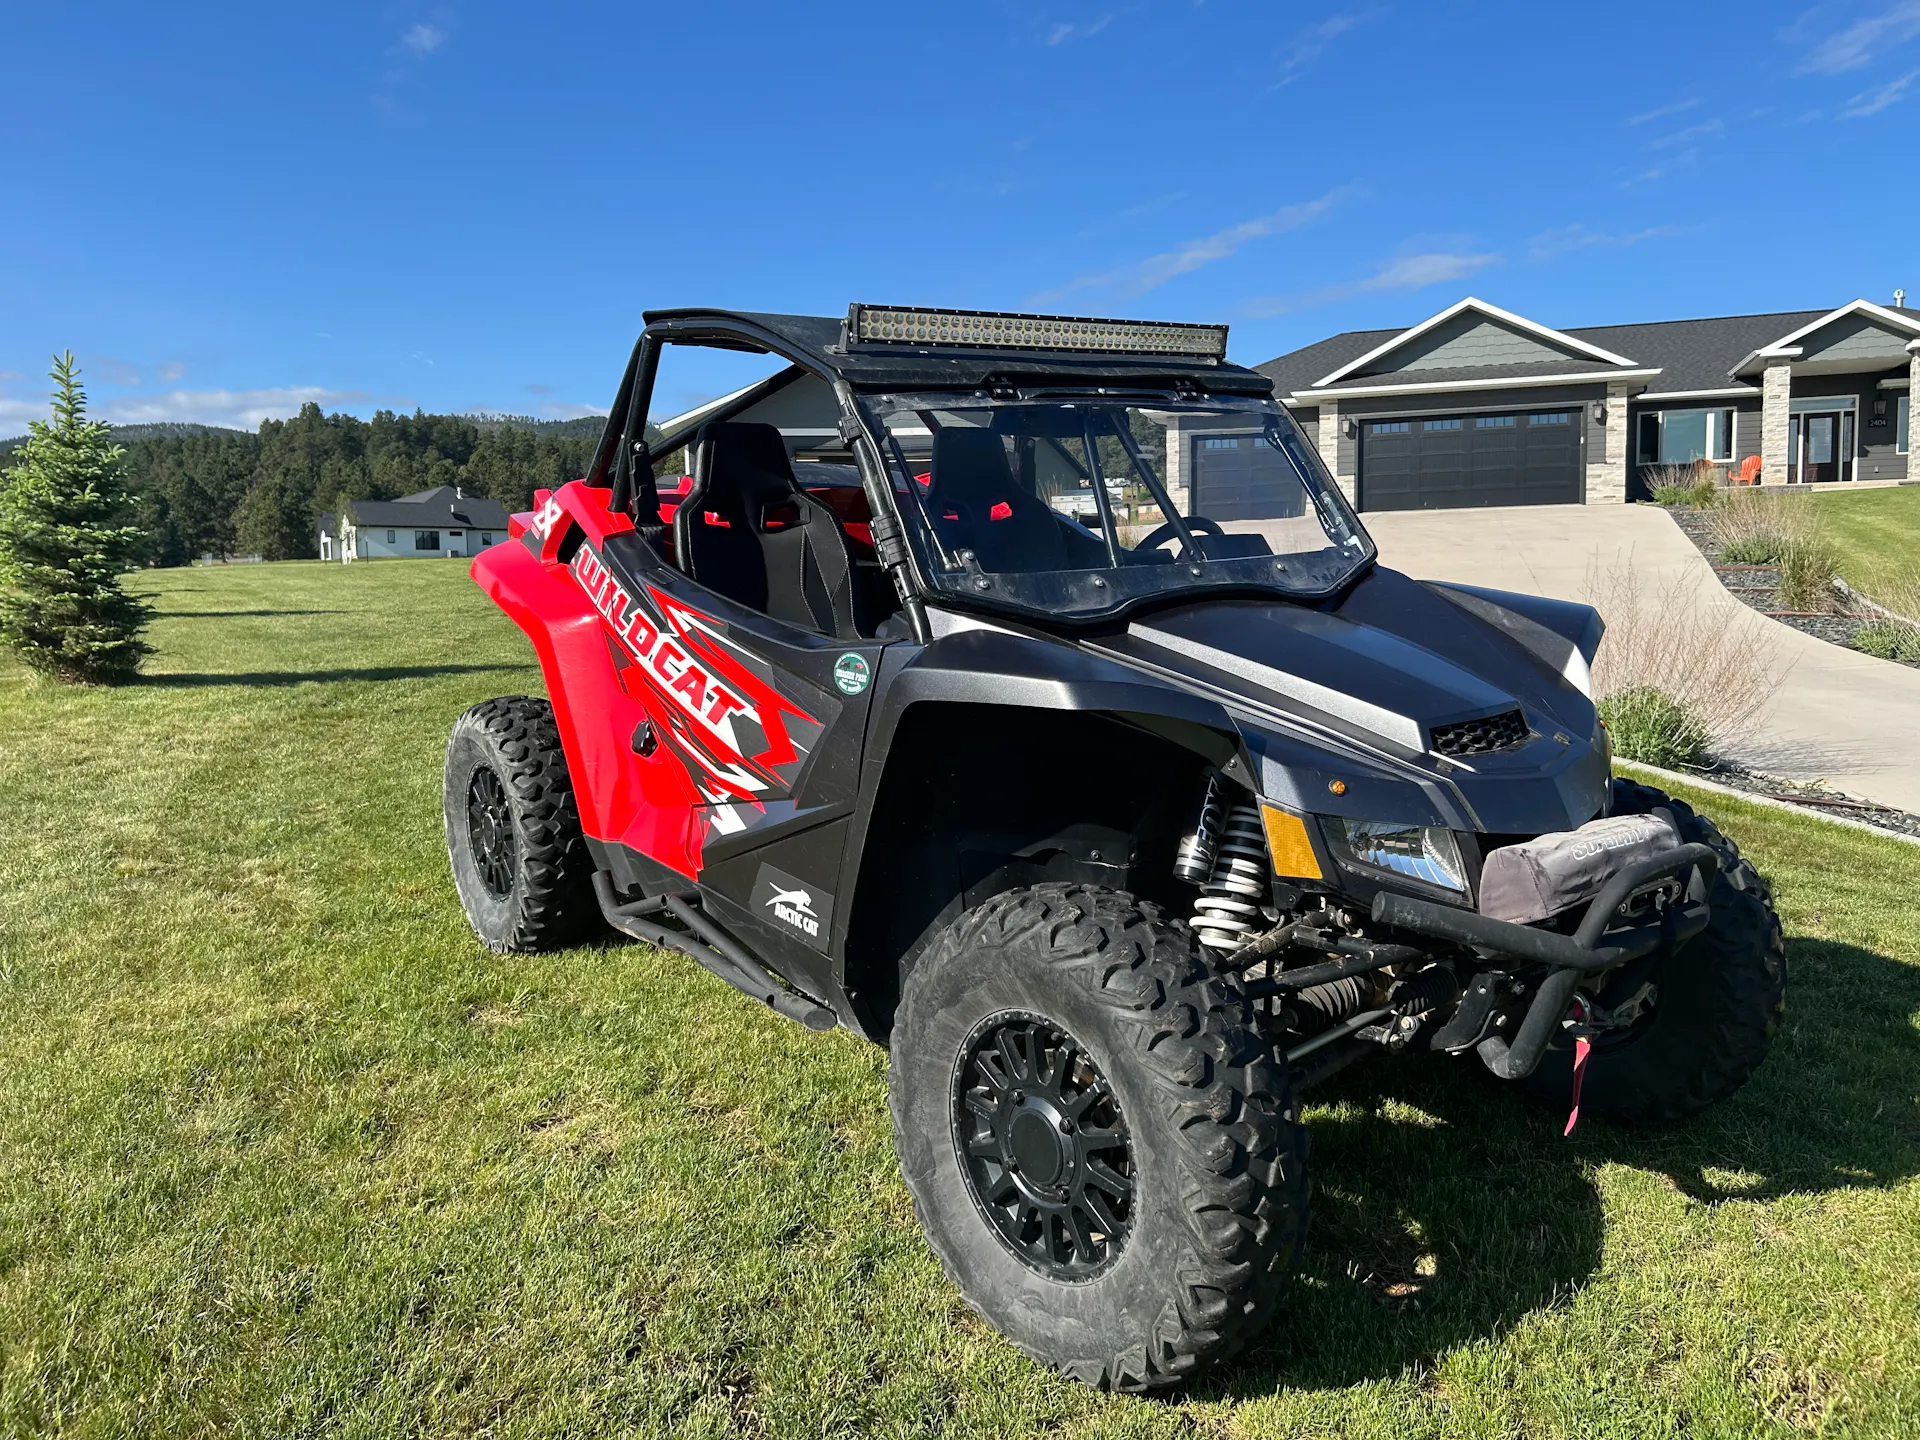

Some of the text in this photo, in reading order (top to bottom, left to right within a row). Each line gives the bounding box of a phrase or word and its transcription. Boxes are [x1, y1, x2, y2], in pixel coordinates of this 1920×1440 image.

[1870, 419, 1886, 427] 2404
[576, 543, 747, 727] WILDCAT
[1193, 775, 1226, 862] FOX
[774, 902, 820, 937] ARCTIC CAT
